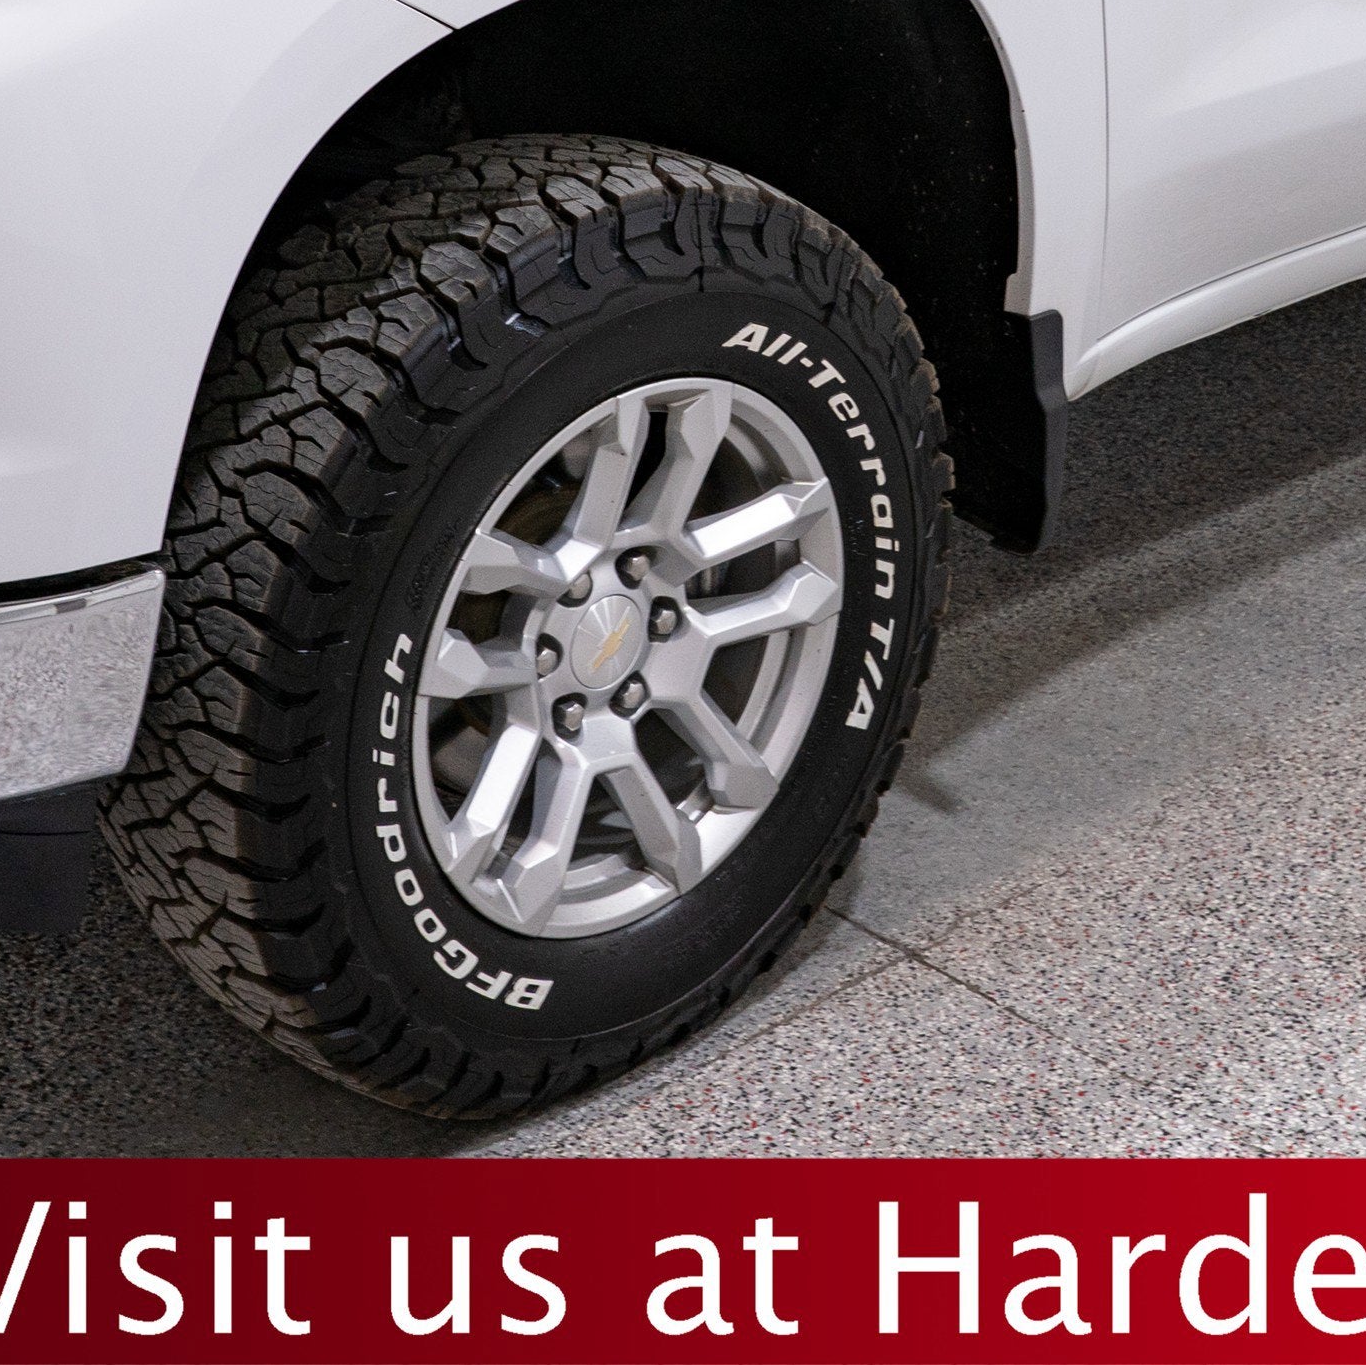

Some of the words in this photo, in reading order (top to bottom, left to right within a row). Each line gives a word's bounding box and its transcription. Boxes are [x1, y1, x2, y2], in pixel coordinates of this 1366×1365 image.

[722, 322, 900, 600] All-Terrain
[845, 618, 895, 731] T/A
[372, 633, 555, 1011] BFGoodrich
